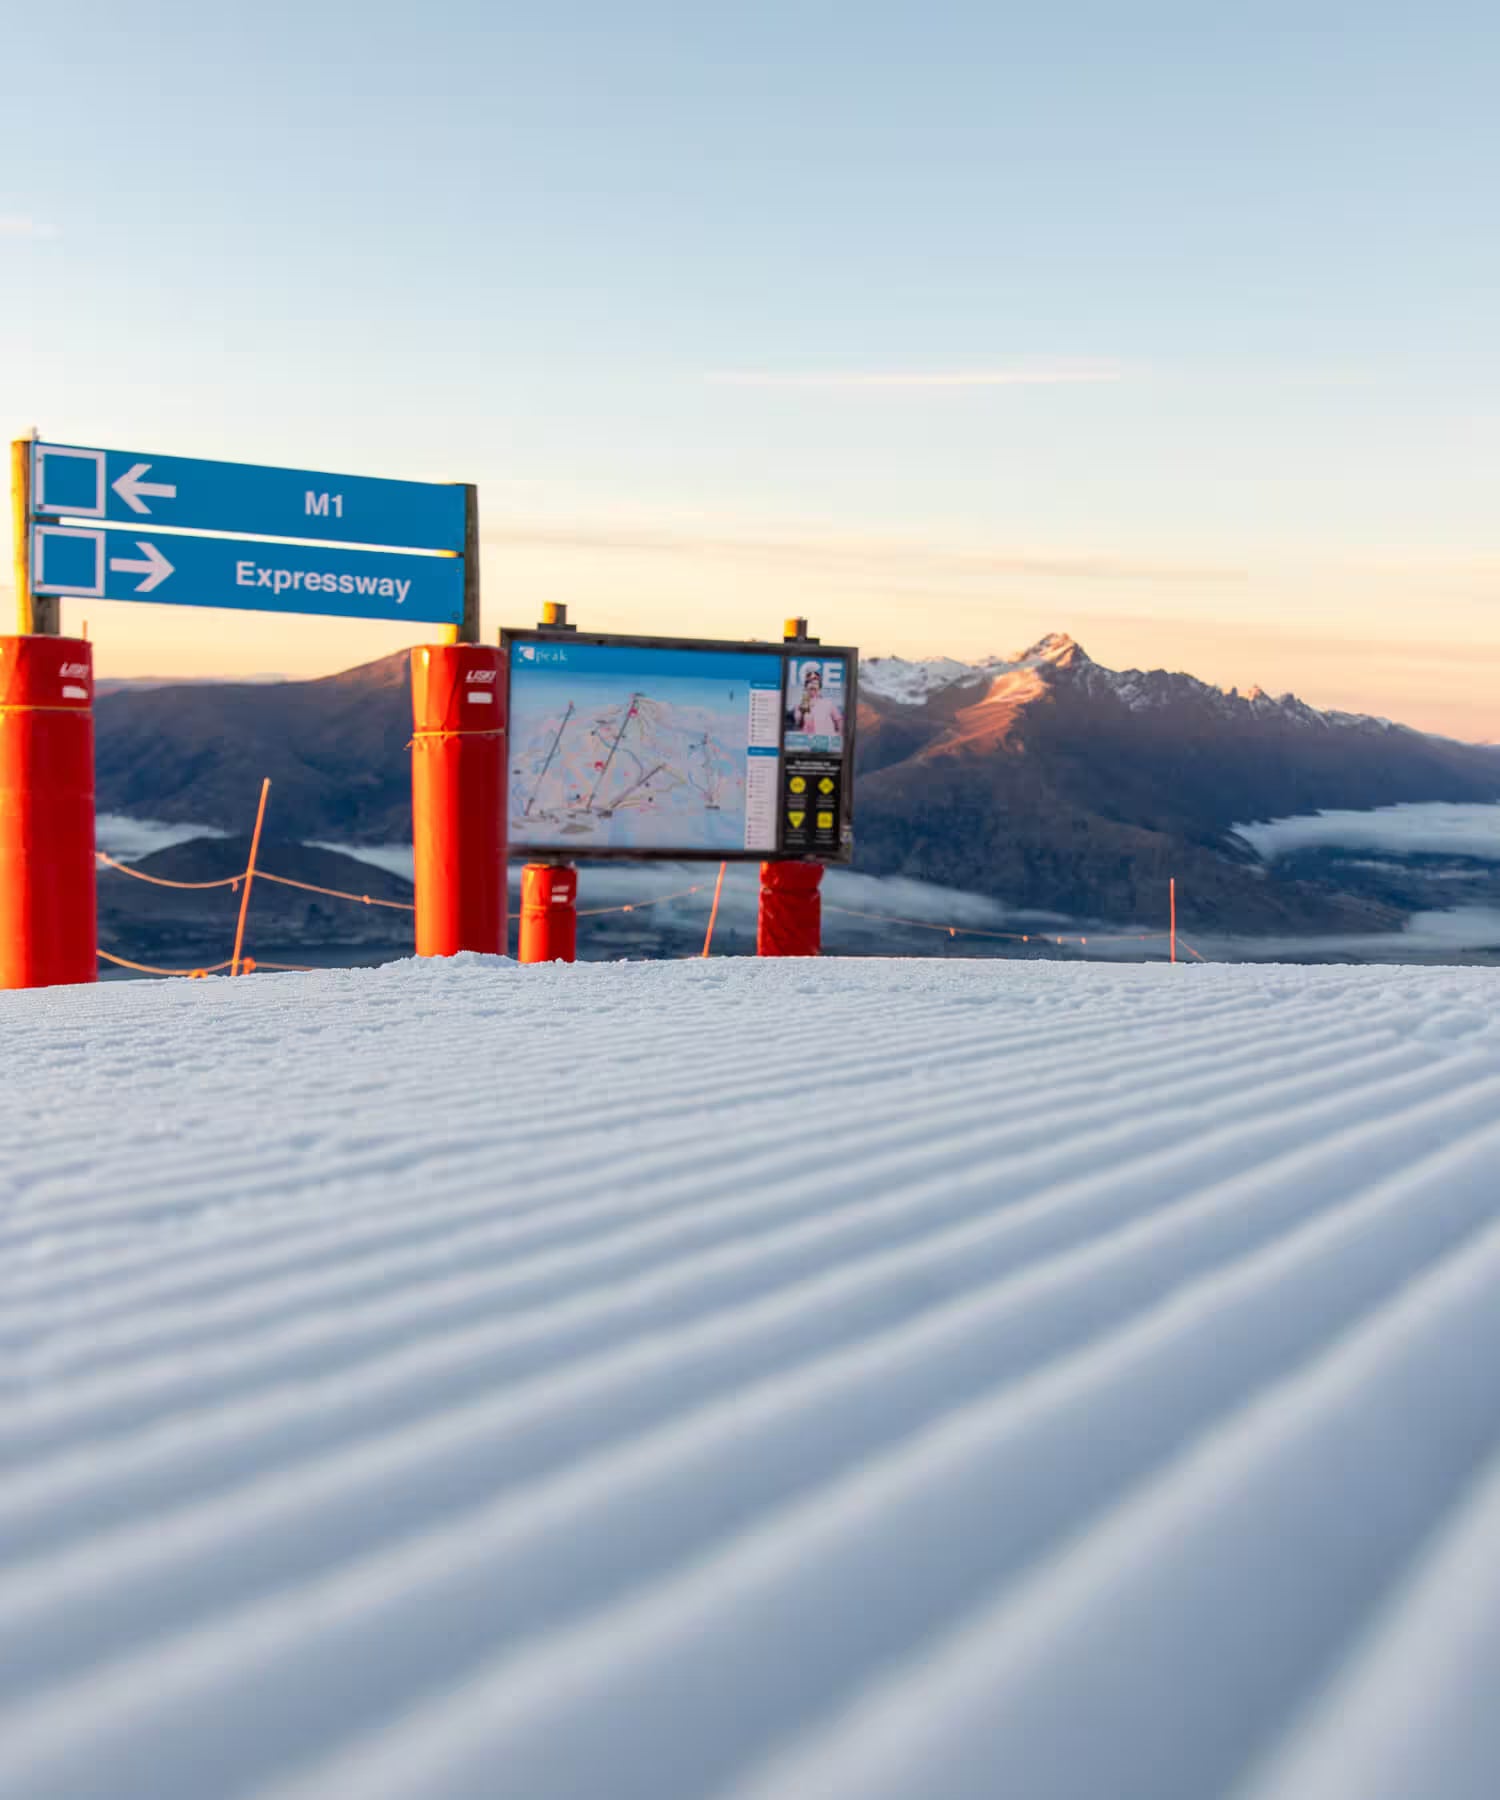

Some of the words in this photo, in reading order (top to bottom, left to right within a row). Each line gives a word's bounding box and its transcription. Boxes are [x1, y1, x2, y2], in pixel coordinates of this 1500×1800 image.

[305, 491, 343, 518] M1
[236, 561, 412, 604] Expressway
[789, 660, 843, 689] ICE
